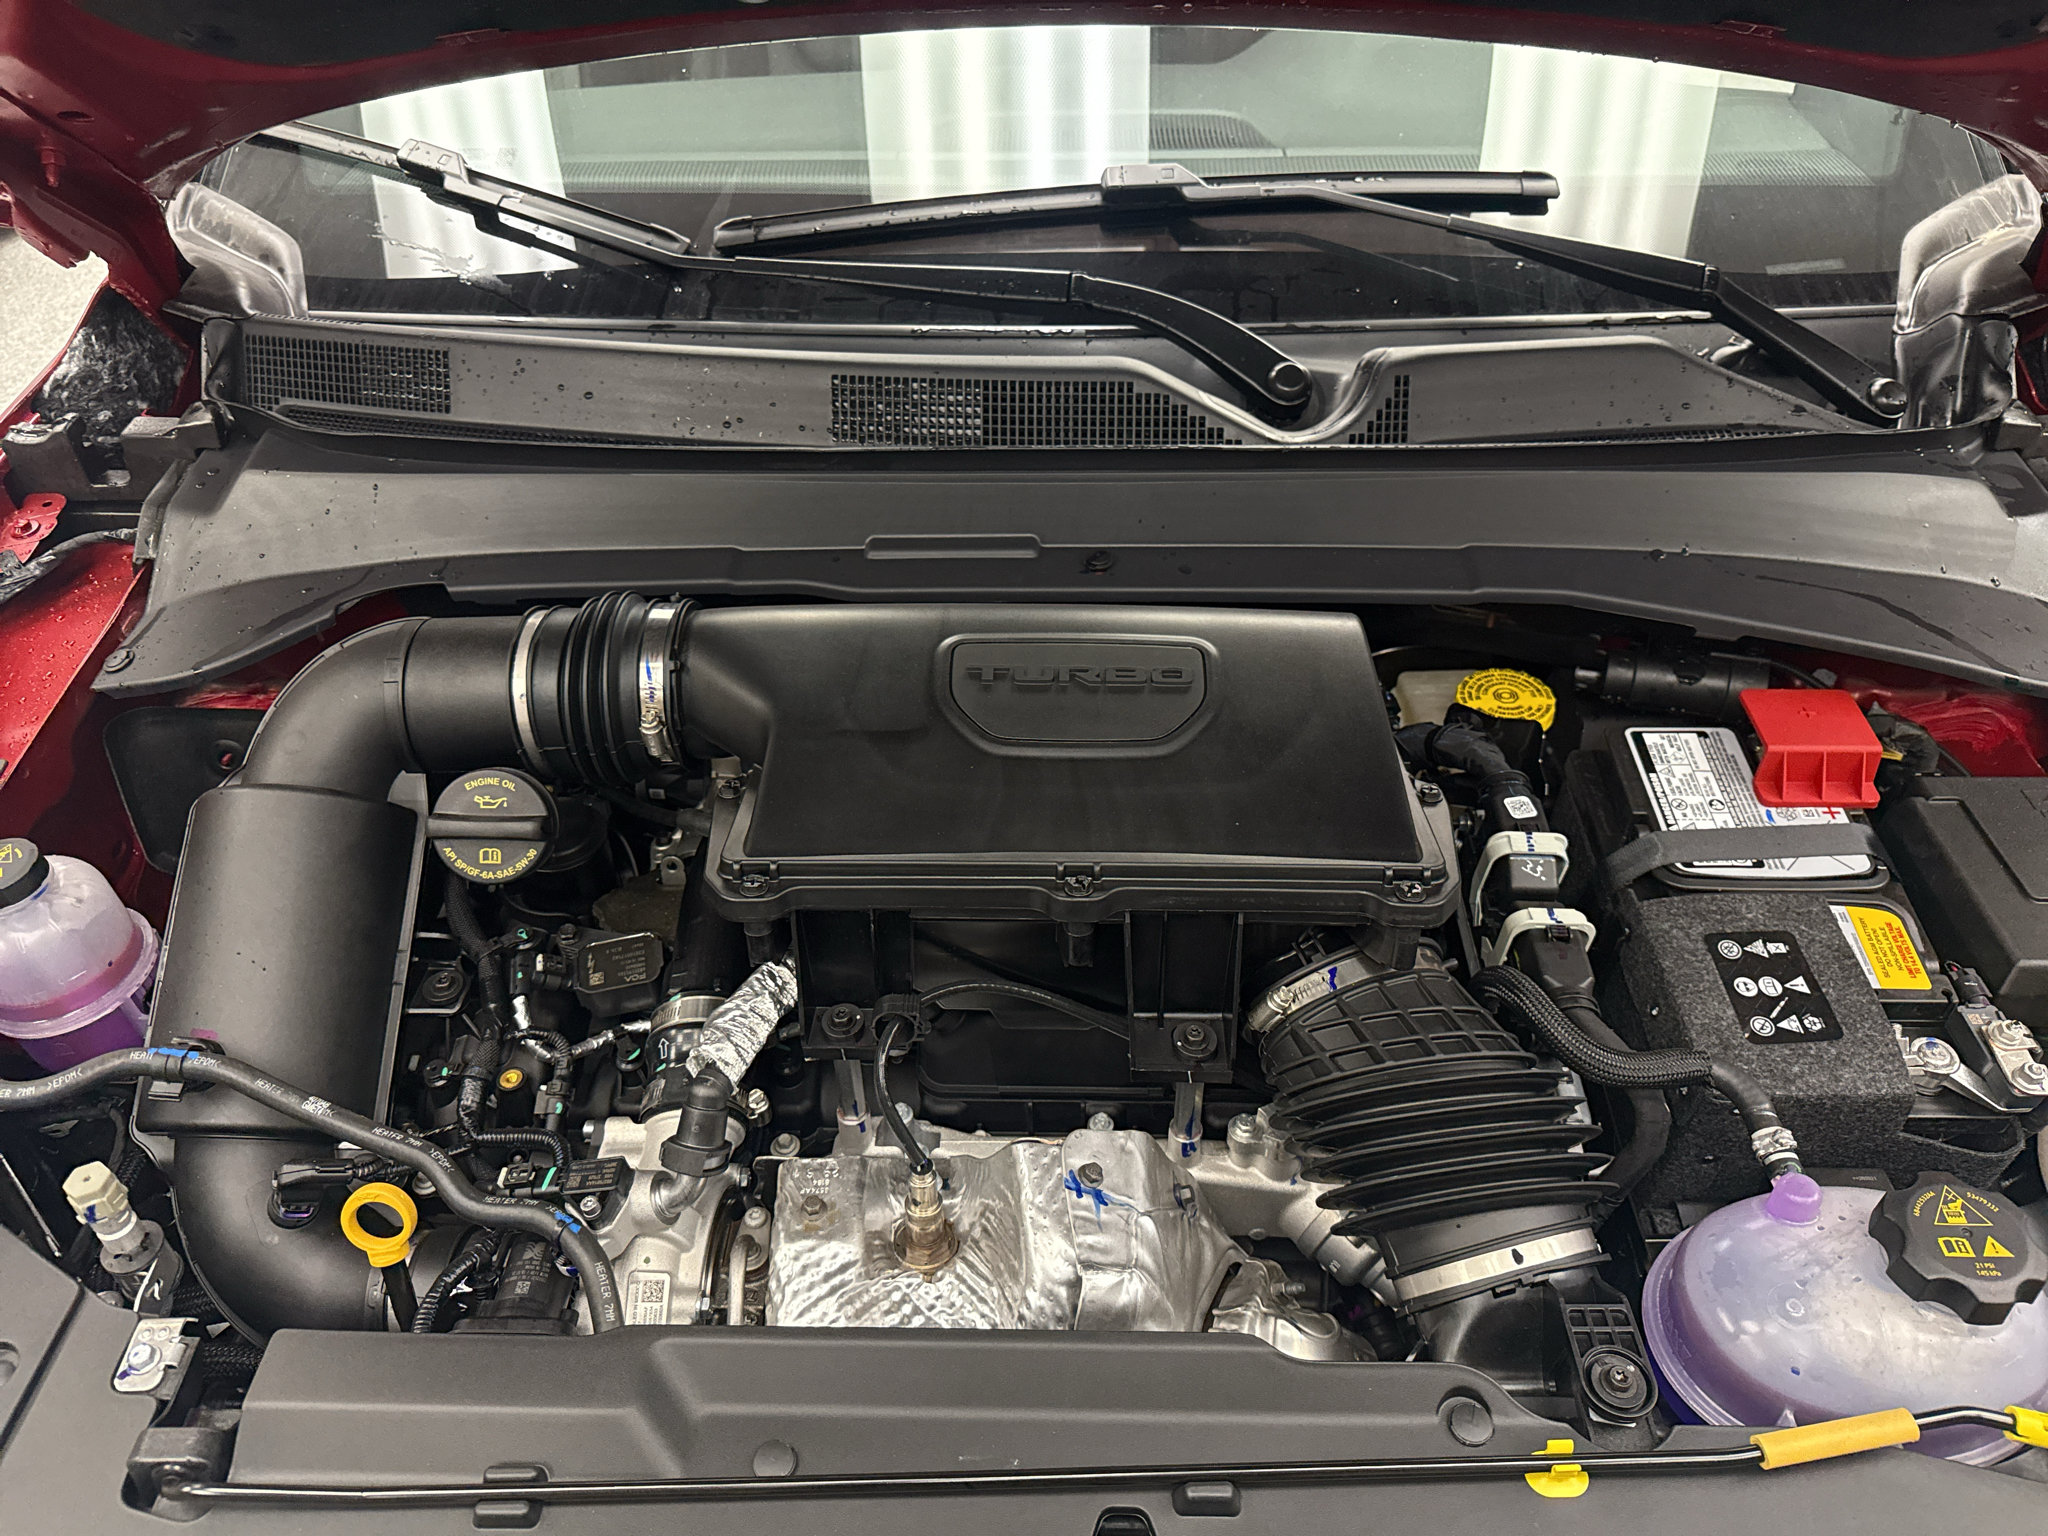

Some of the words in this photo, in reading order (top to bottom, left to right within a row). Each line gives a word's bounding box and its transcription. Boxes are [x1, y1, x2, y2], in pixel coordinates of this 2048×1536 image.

[966, 664, 1193, 687] TURBO
[464, 777, 500, 791] ENGINE
[502, 779, 516, 792] OIL
[443, 847, 455, 862] API
[454, 848, 538, 880] SP/GF-6A-SAE-5W-30
[371, 1126, 404, 1140] HEATER
[482, 1195, 518, 1205] HEATER
[594, 1261, 611, 1299] HEATER
[603, 1303, 616, 1322] 7MM
